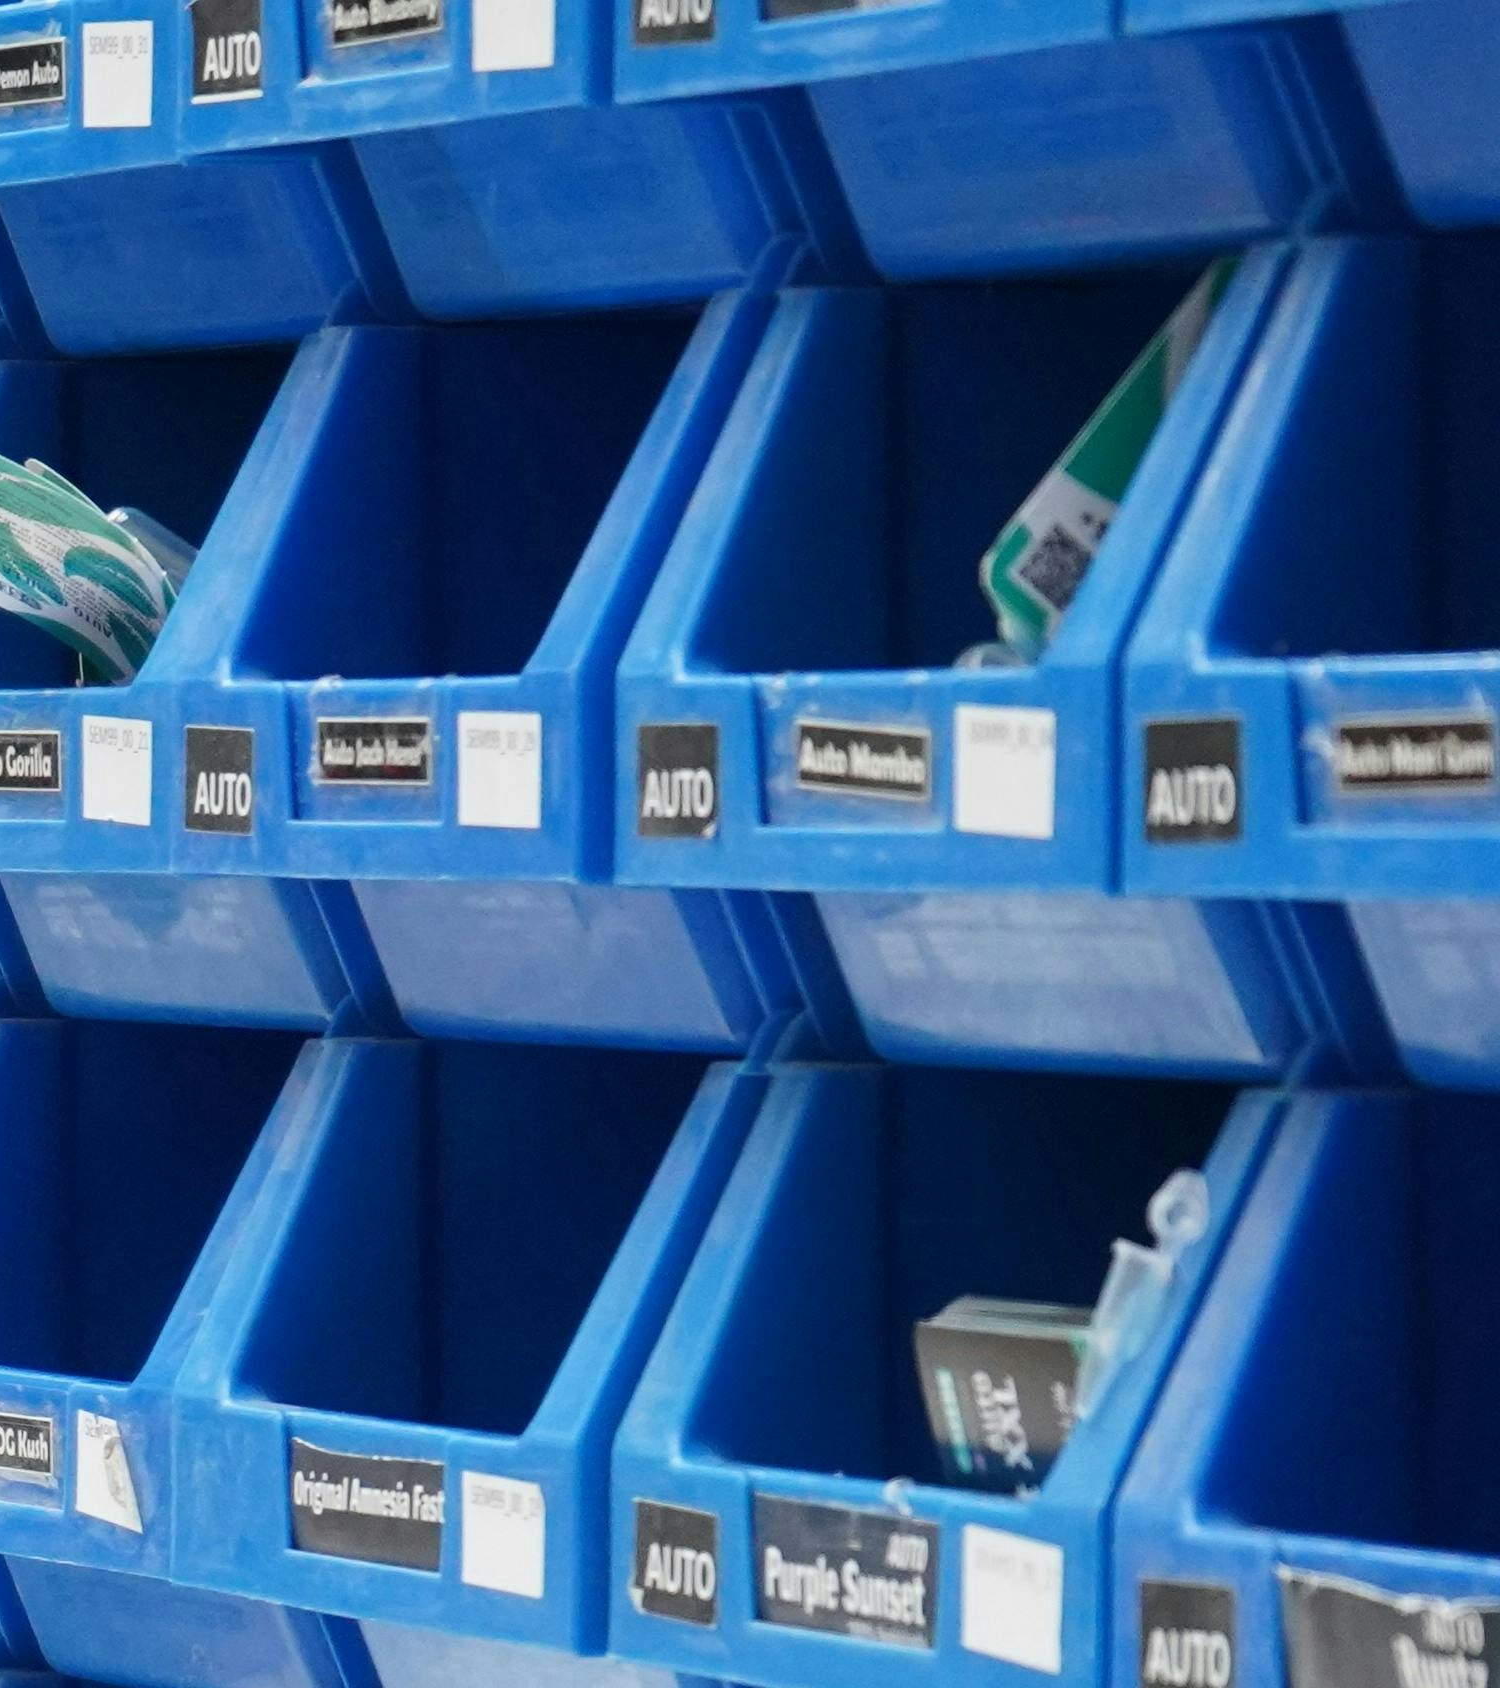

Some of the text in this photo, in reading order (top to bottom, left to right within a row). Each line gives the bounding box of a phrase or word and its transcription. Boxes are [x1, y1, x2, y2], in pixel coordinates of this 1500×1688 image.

[31, 60, 59, 86] Auto
[203, 31, 260, 81] AUTO
[5, 744, 52, 778] Gorilla
[323, 740, 355, 766] Auto
[800, 737, 848, 775] Auto
[194, 772, 250, 816] AUTO
[641, 768, 714, 818] AUTO
[1147, 764, 1237, 826] AUTO
[16, 1431, 49, 1461] Kush
[292, 1470, 445, 1523] Original Amnesia Fast
[644, 1541, 715, 1602] AUTO
[886, 1532, 929, 1574] AUTO
[764, 1546, 839, 1616] Purple
[840, 1558, 926, 1626] Sunset
